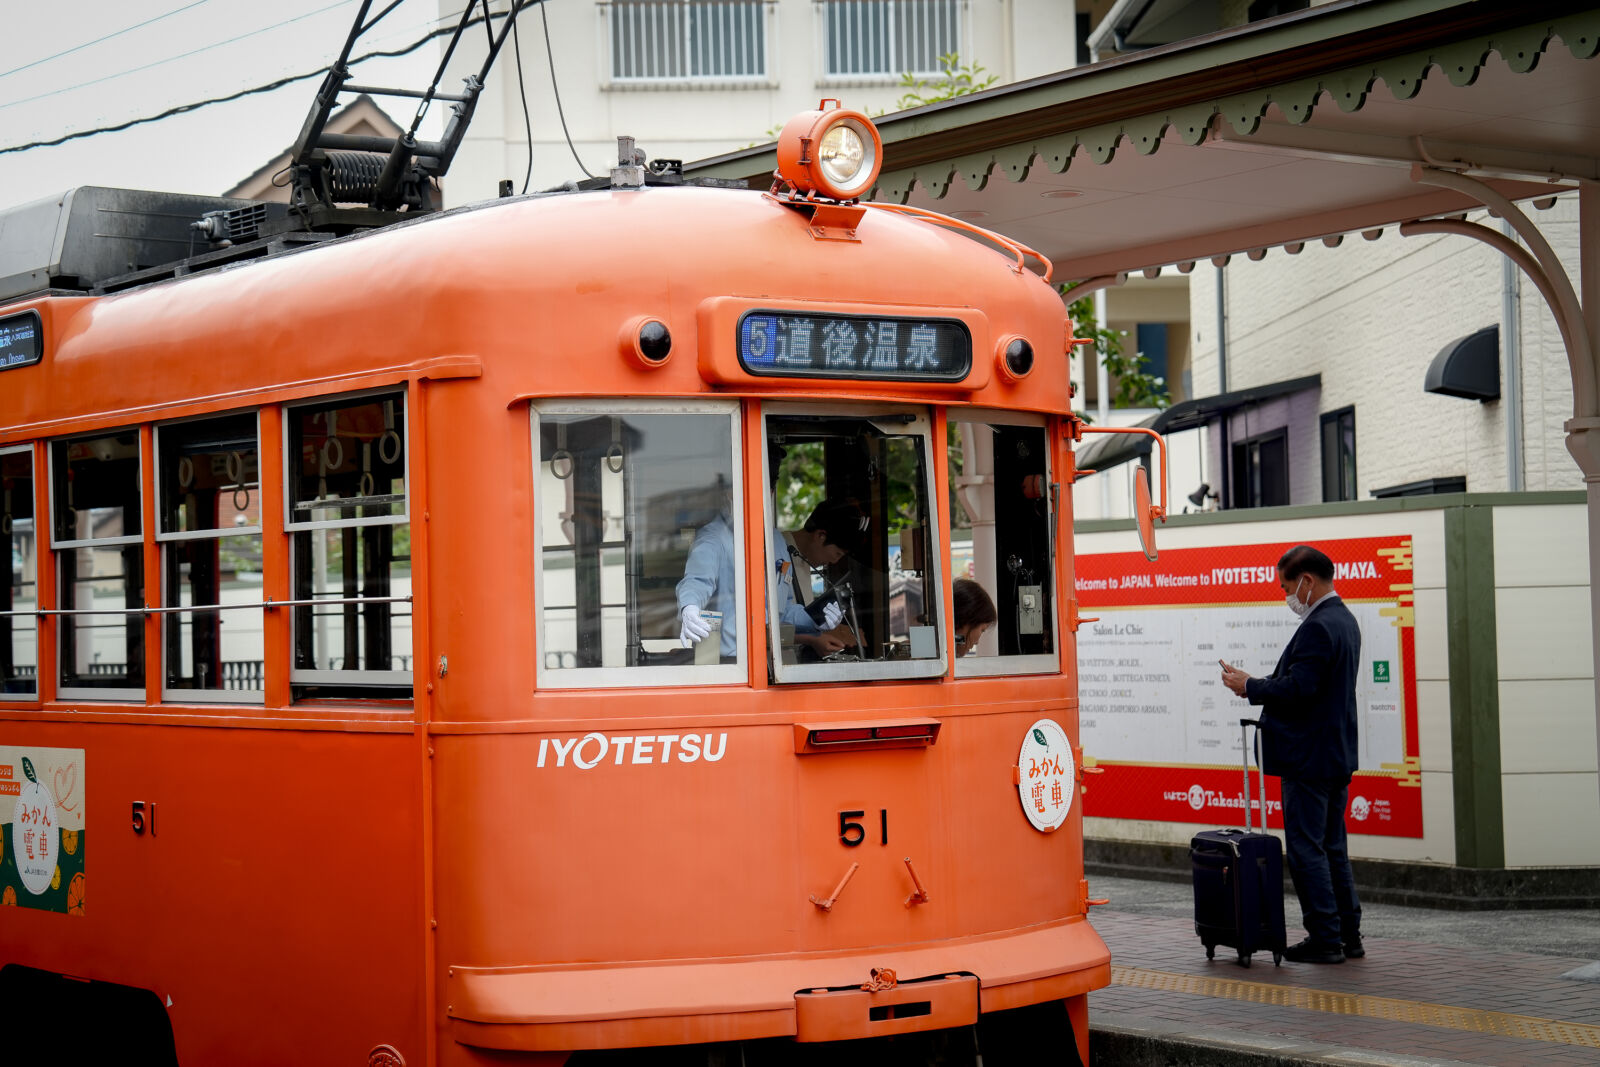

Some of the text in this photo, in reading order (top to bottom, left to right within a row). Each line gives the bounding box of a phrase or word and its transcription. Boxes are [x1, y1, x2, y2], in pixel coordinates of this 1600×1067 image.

[750, 318, 940, 368] 5 道後温泉
[1108, 577, 1119, 590] to
[1120, 574, 1154, 589] JAPAN.
[1155, 573, 1198, 588] Welcome
[1200, 574, 1210, 586] to
[1211, 566, 1275, 586] IYOTETSU
[536, 732, 728, 770] IYOTETSU
[1028, 753, 1065, 779] みかん
[1031, 780, 1064, 813] 電車
[1204, 790, 1282, 815] Takashmya
[21, 803, 51, 827] みかん
[132, 801, 157, 837] 51
[838, 808, 889, 847] 51
[23, 828, 49, 861] 電車
